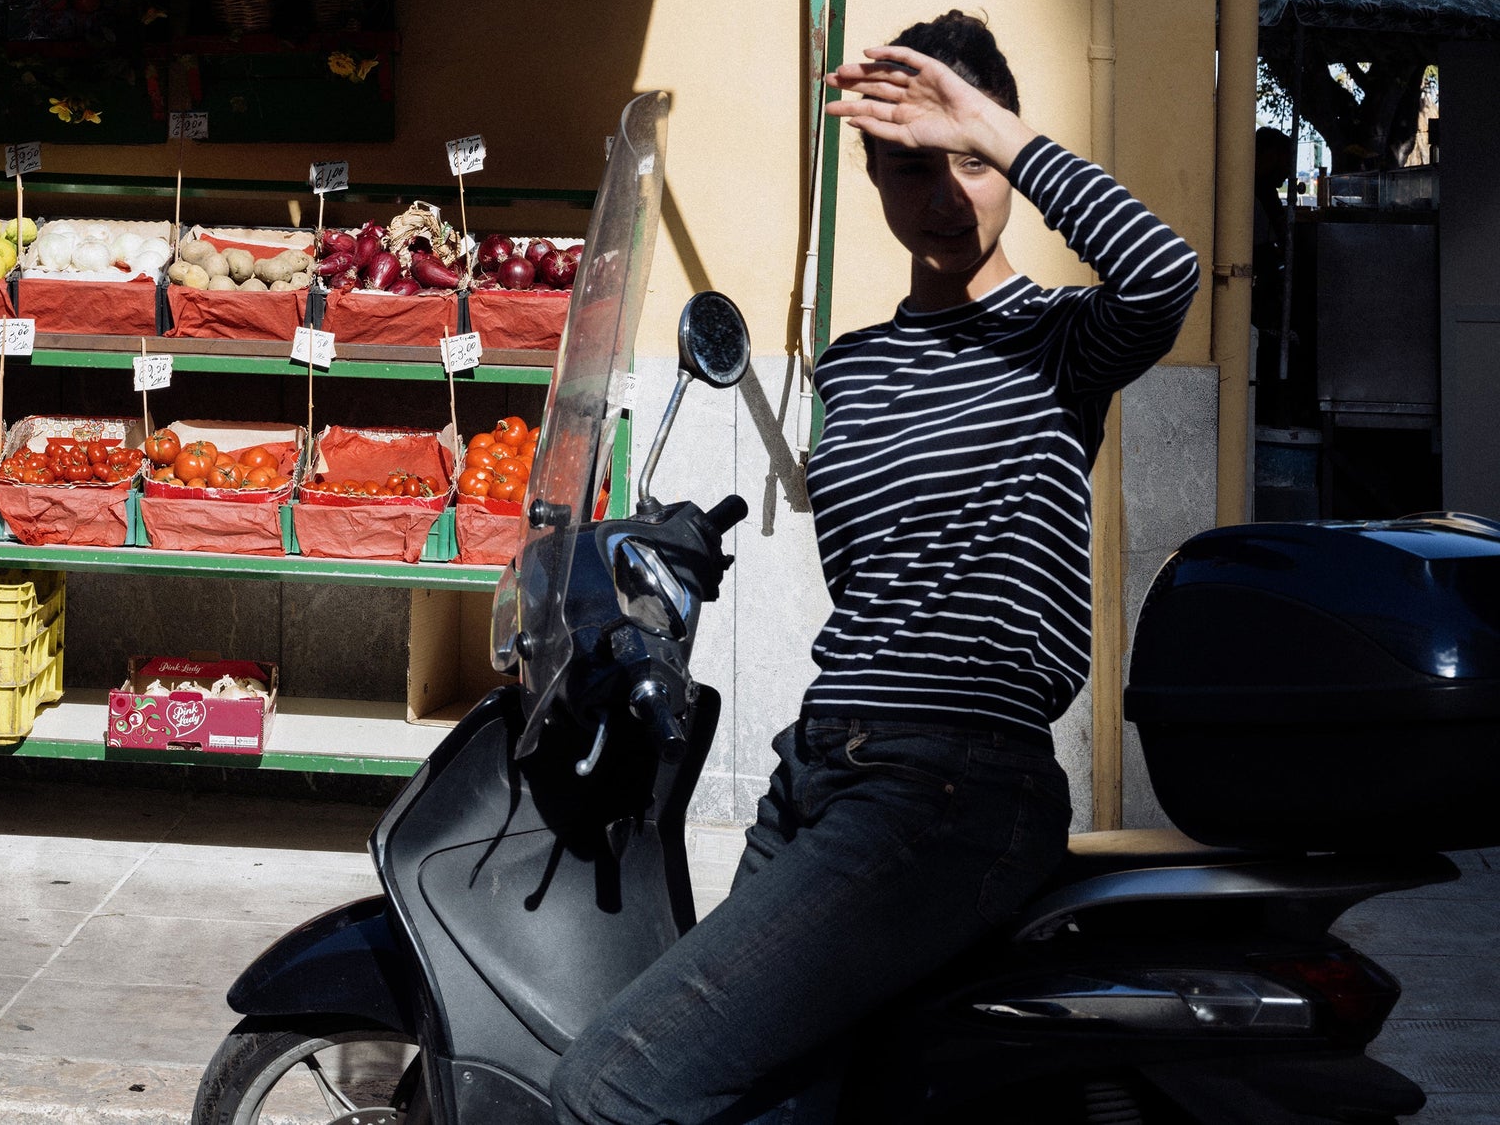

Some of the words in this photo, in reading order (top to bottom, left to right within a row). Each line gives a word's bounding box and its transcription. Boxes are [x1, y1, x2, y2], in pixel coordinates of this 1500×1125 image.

[158, 661, 180, 672] Pink
[172, 702, 199, 720] Pink
[176, 713, 201, 727] Lady
